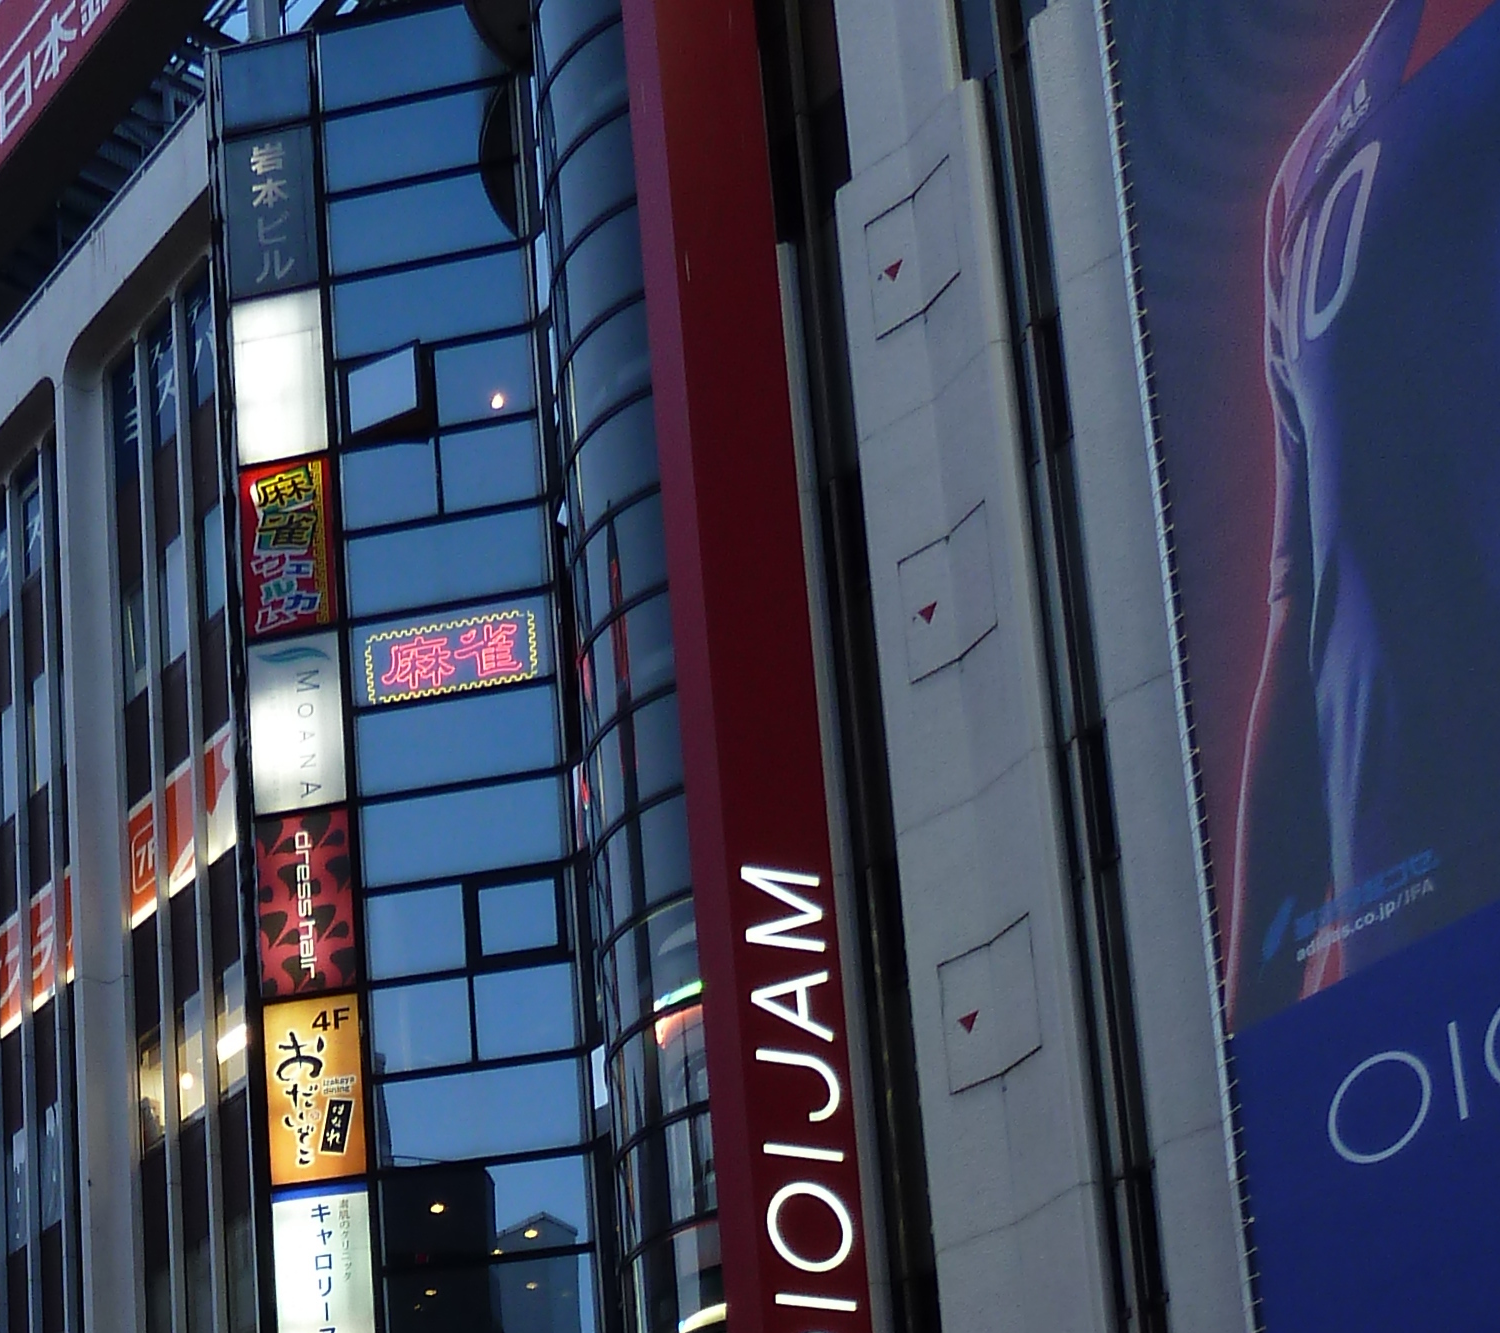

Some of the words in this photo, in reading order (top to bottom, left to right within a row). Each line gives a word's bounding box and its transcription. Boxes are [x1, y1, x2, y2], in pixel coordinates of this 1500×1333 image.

[250, 141, 297, 284] 岩本ビル
[1280, 139, 1381, 362] 10
[254, 467, 319, 552] 麻雀
[382, 623, 522, 690] 麻雀
[295, 670, 323, 800] MOANA
[311, 1007, 350, 1032] 4F
